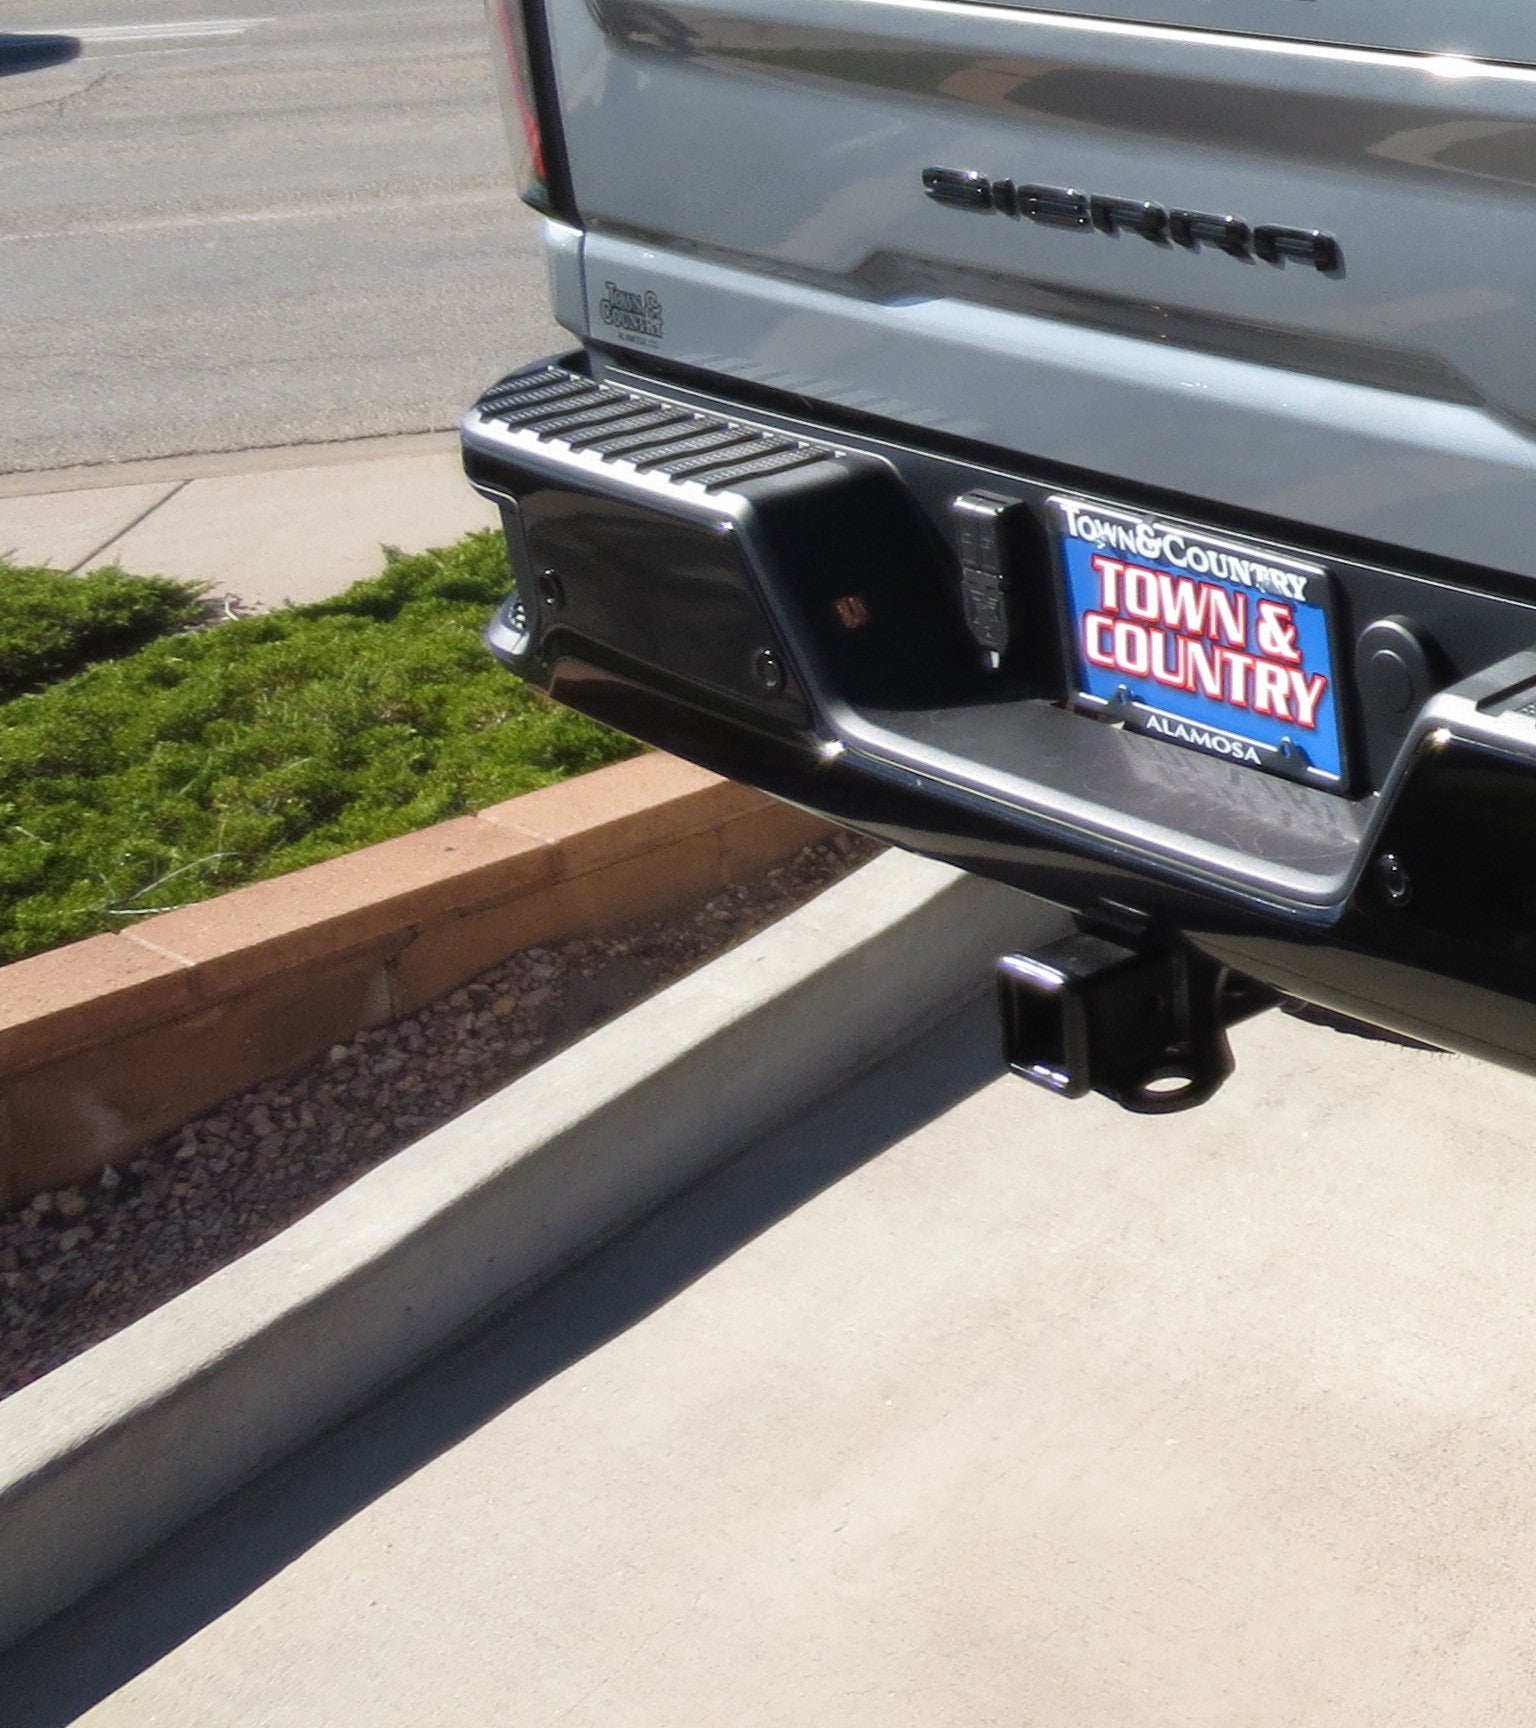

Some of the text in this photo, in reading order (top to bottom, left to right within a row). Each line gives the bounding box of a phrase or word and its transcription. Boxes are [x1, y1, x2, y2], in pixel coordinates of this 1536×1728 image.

[921, 165, 1345, 278] SIERRA
[1093, 553, 1303, 663] TOWN &
[1083, 611, 1327, 730] COUNTRY
[1146, 714, 1261, 765] ALAMOSA
